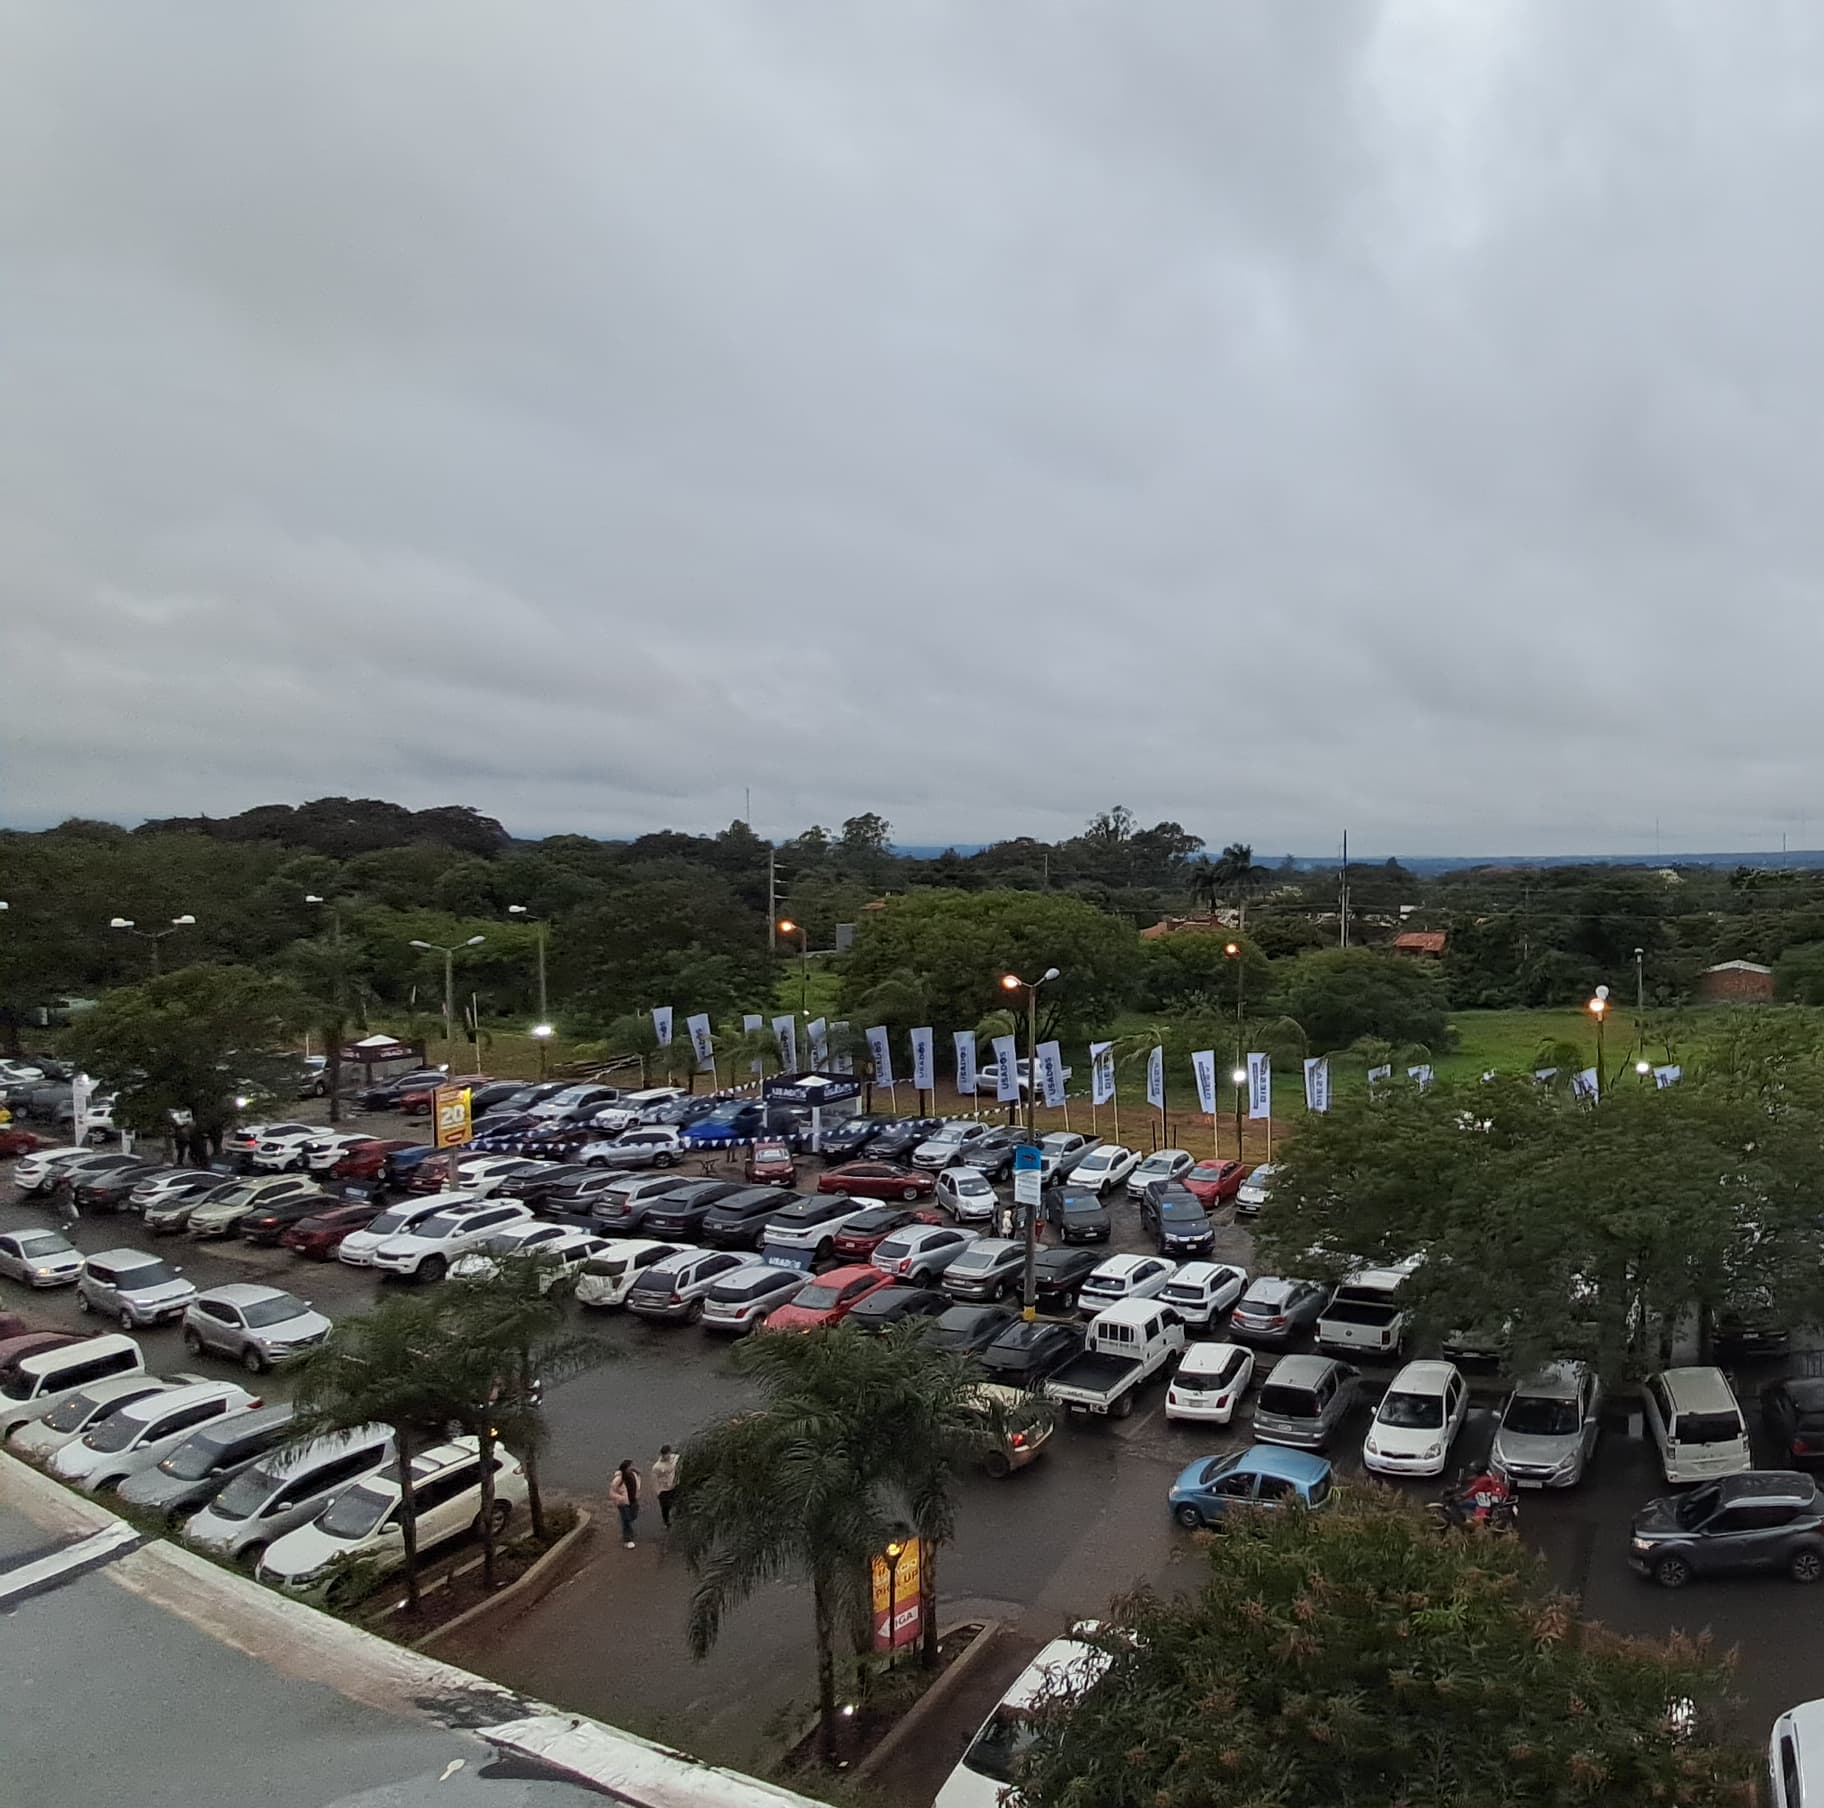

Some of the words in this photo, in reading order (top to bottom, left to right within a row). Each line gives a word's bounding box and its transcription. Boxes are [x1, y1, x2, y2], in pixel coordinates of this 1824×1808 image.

[959, 1046, 967, 1084] USADOS
[1000, 1051, 1009, 1090] USADOS
[1045, 1057, 1056, 1096] USADOS
[903, 1569, 919, 1584] UP
[891, 1611, 914, 1628] IGA
